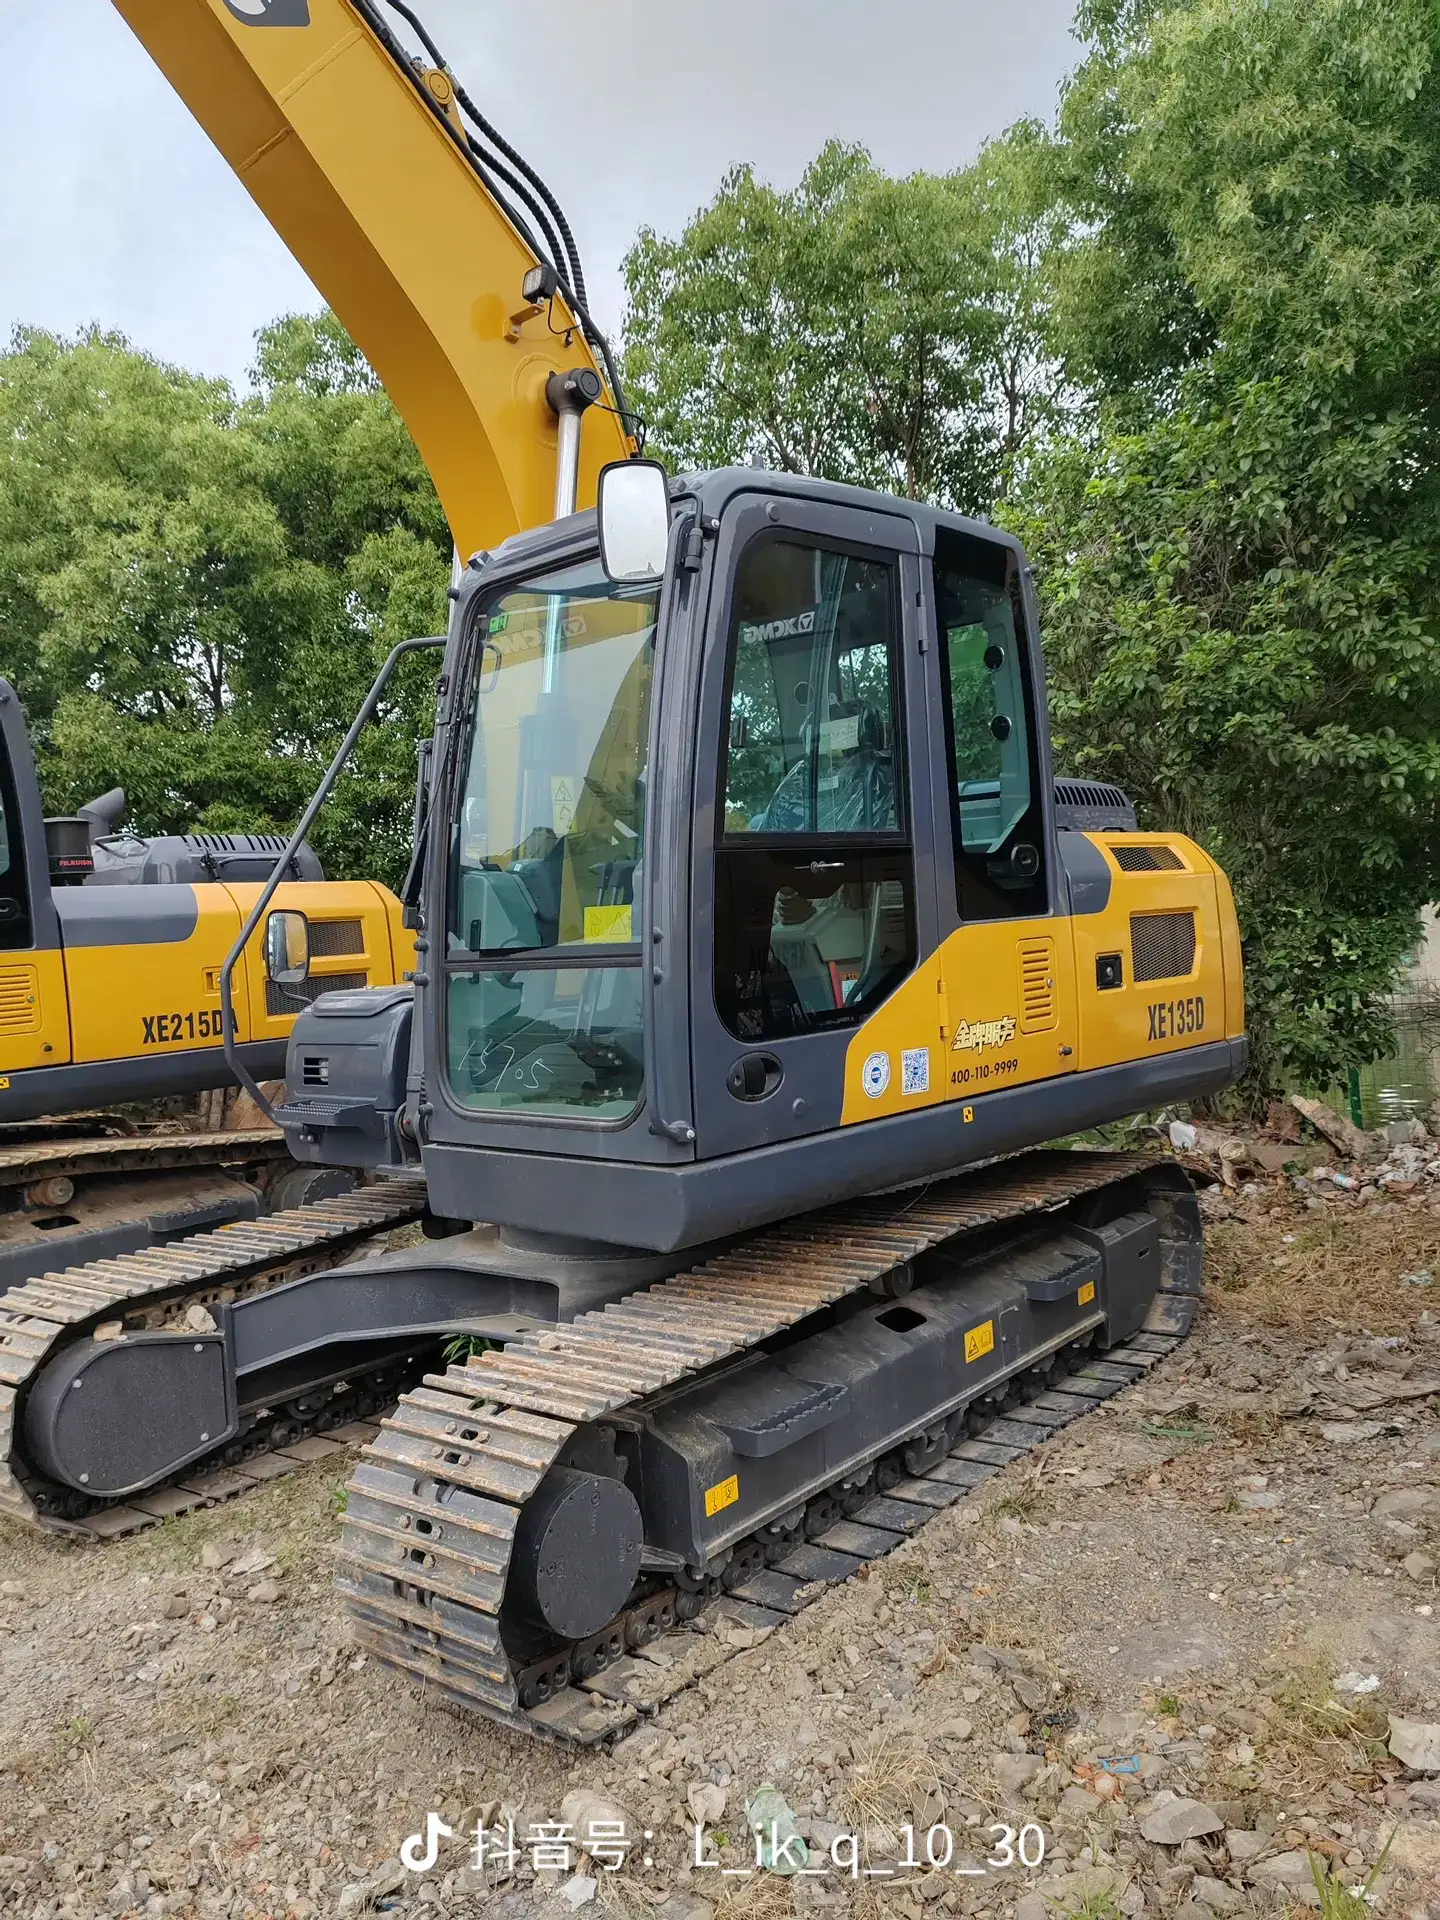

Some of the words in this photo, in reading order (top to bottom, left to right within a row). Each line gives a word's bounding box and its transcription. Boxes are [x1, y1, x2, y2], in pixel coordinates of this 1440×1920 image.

[951, 1016, 1017, 1056] 金牌服务
[1147, 996, 1204, 1042] XE135D
[951, 1058, 1018, 1085] 400-110-9999
